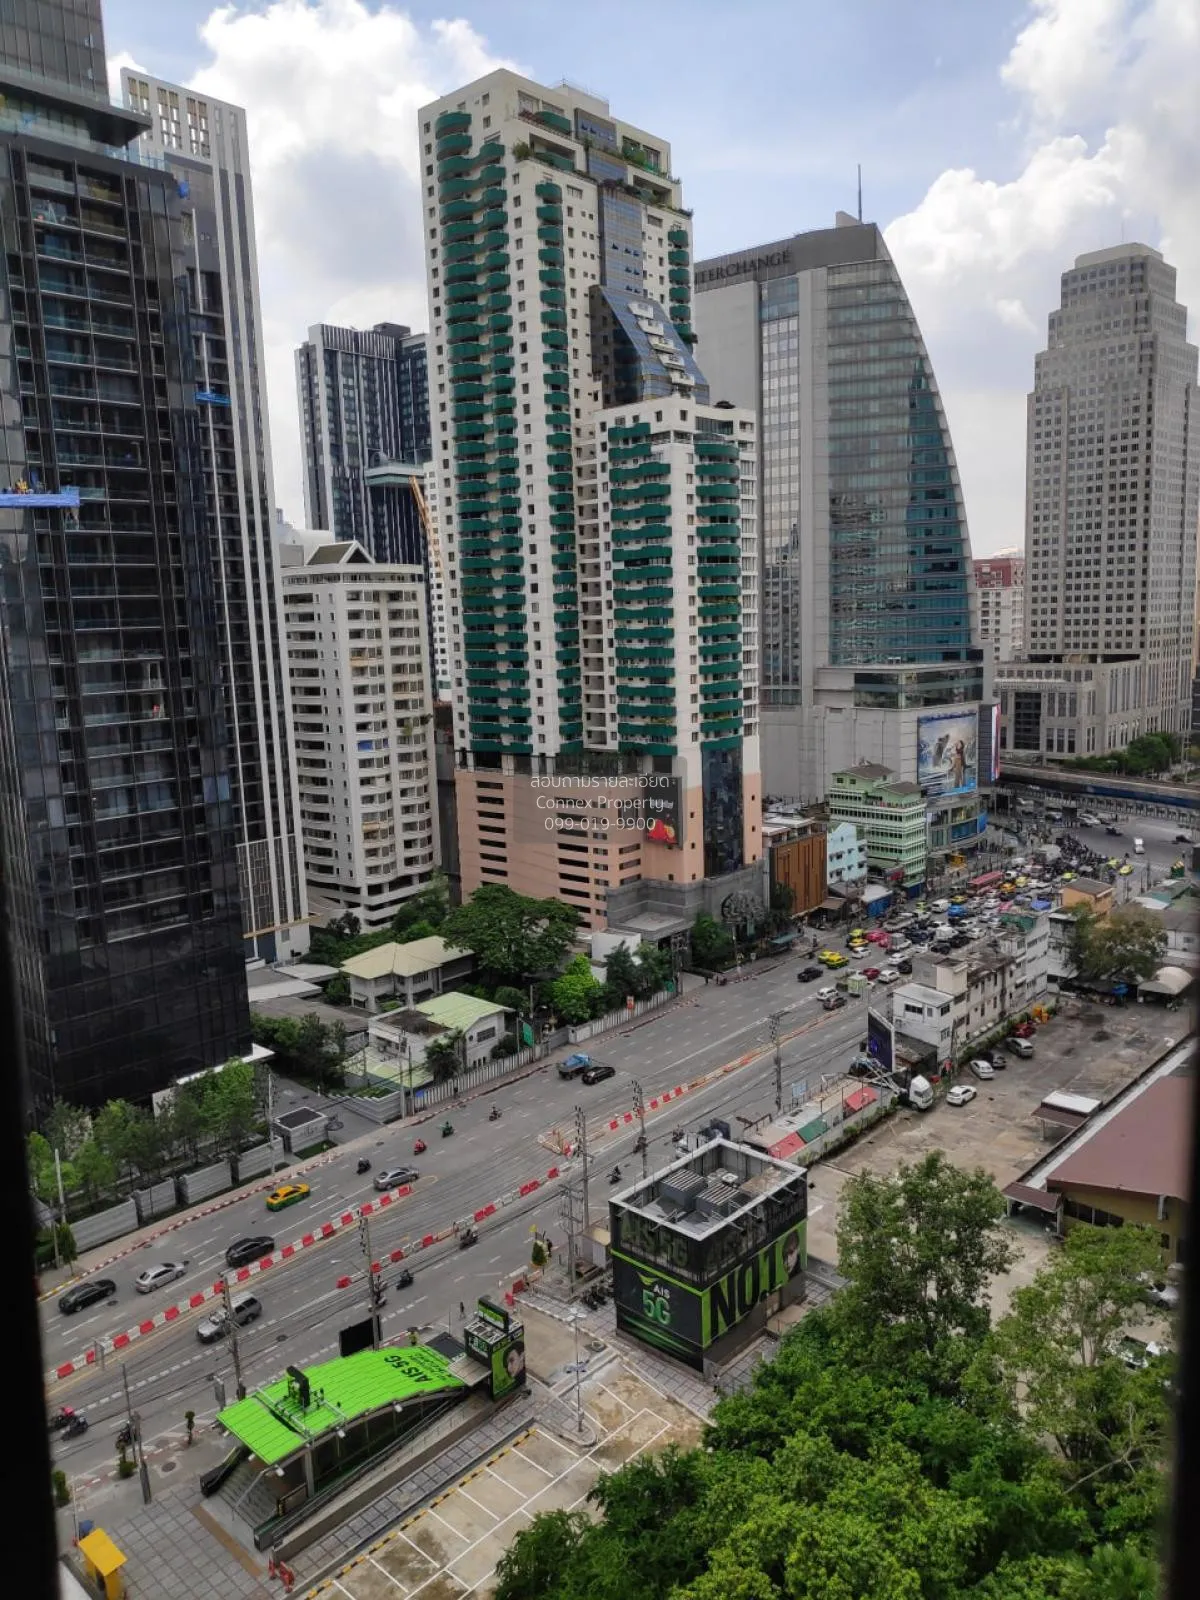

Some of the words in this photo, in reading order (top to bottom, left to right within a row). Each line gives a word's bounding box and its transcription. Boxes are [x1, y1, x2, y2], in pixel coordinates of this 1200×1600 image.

[694, 250, 790, 285] TERCHANGE
[653, 1284, 671, 1299] AIS
[642, 1288, 671, 1325] 5G
[384, 1354, 410, 1369] 5G
[401, 1366, 433, 1383] AIS
